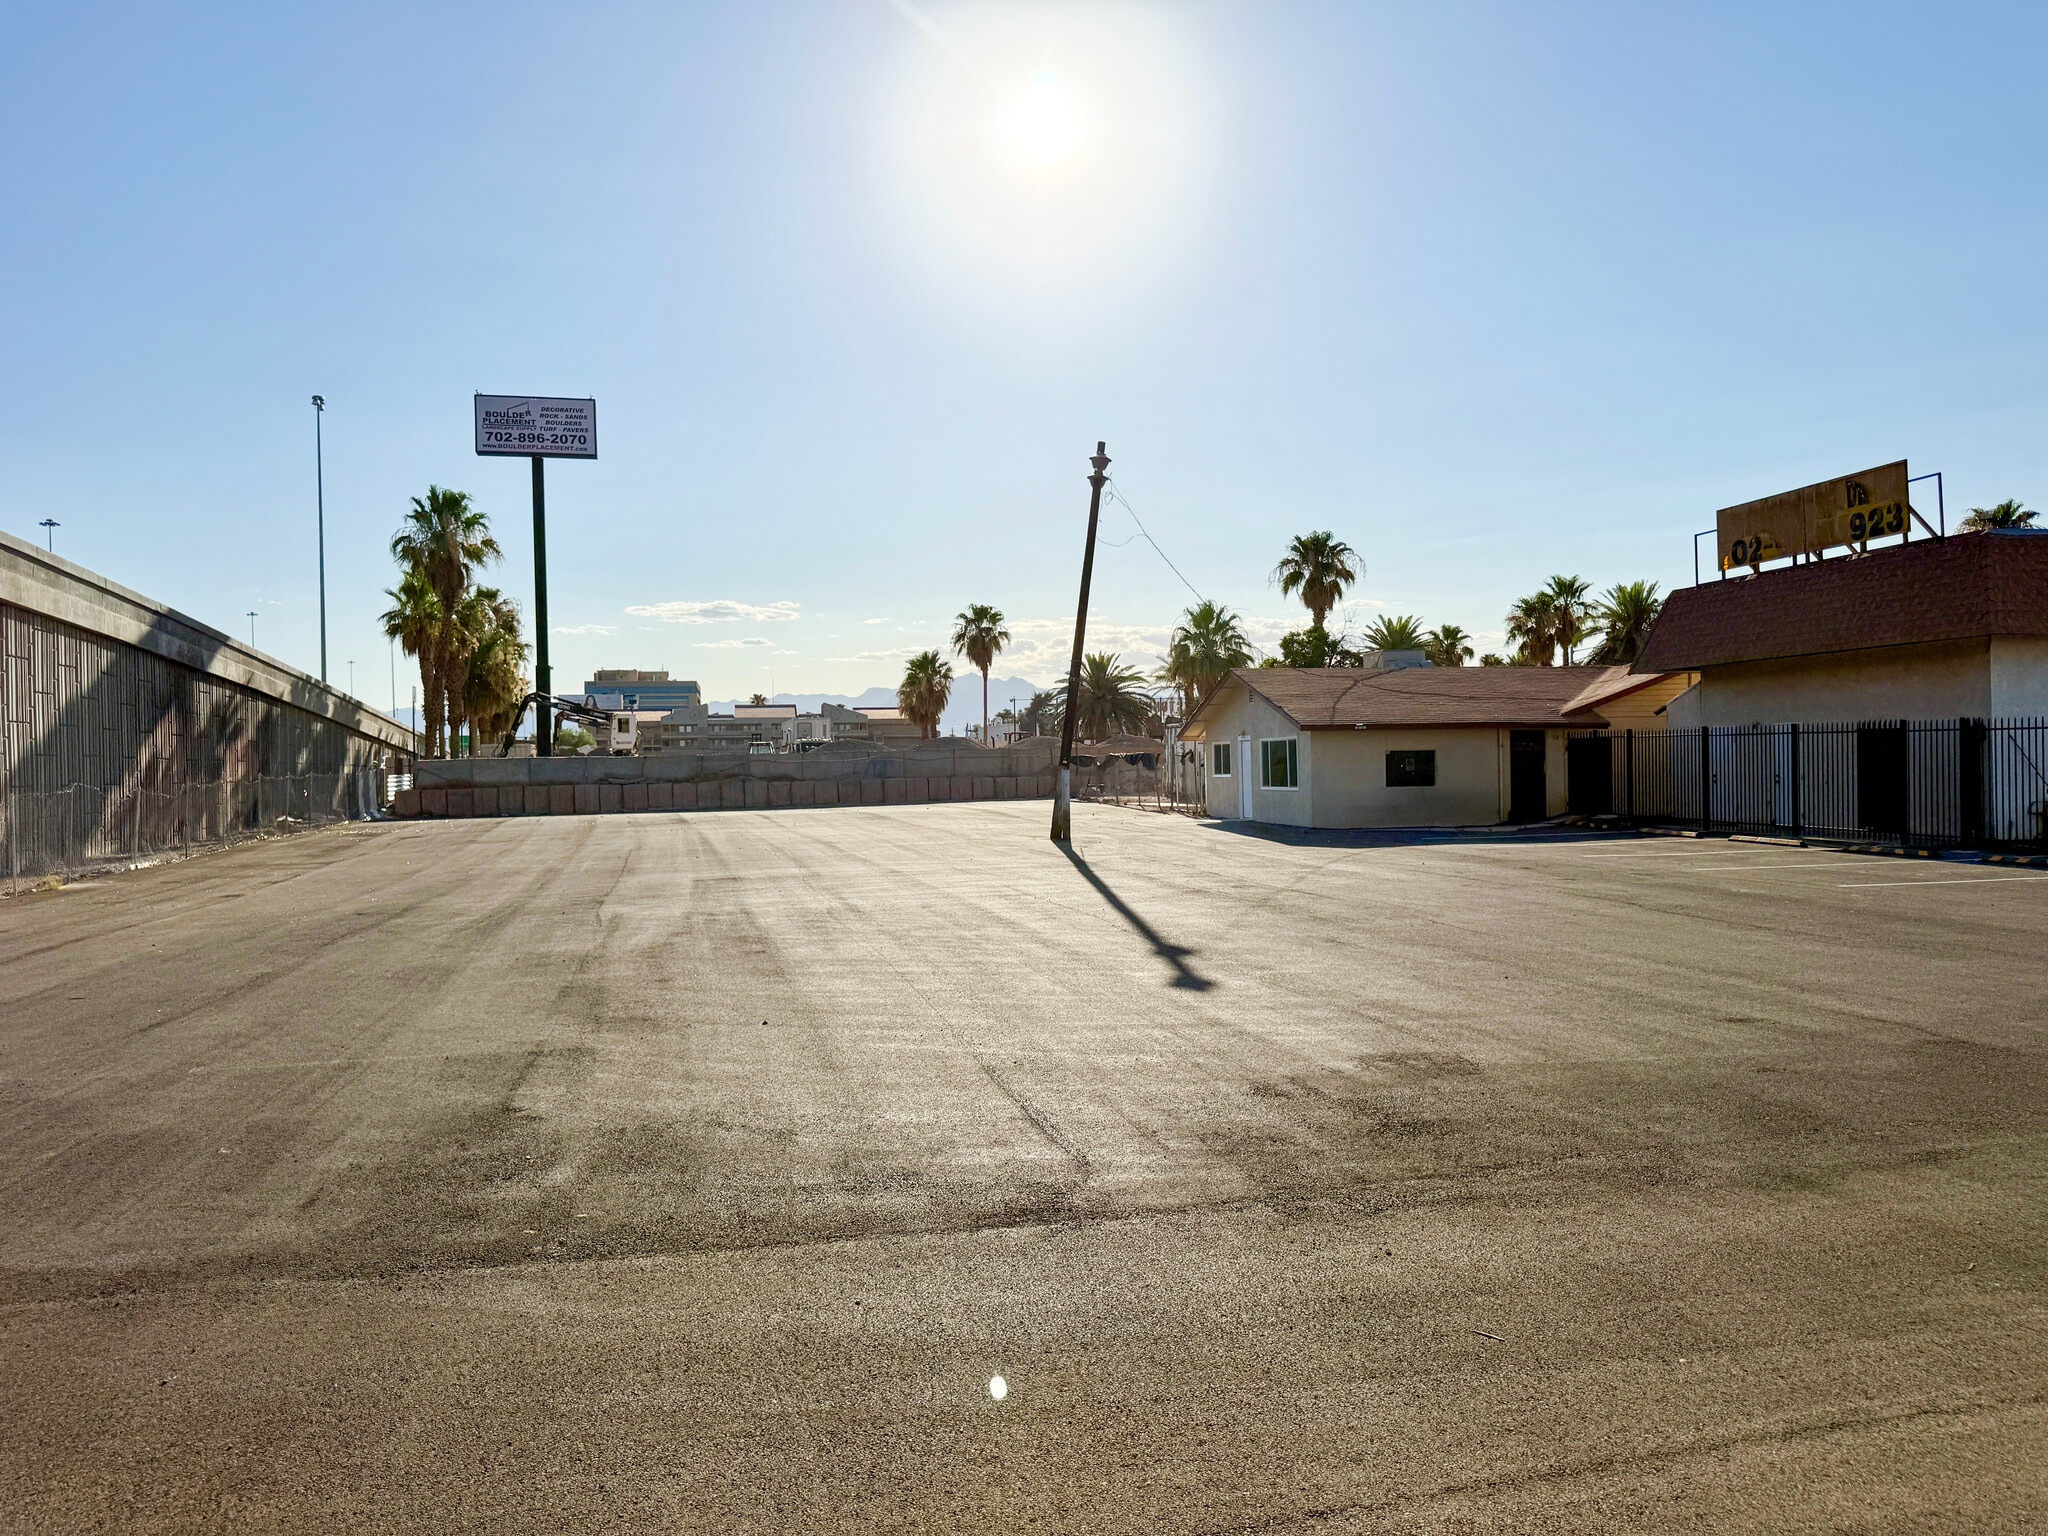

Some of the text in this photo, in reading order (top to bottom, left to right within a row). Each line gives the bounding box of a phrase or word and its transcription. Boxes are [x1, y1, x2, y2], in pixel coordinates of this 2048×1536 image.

[484, 431, 587, 445] 702-896-2070
[482, 443, 588, 452] www.BOULDERPLACEMENT.com
[1850, 502, 1904, 541] 923
